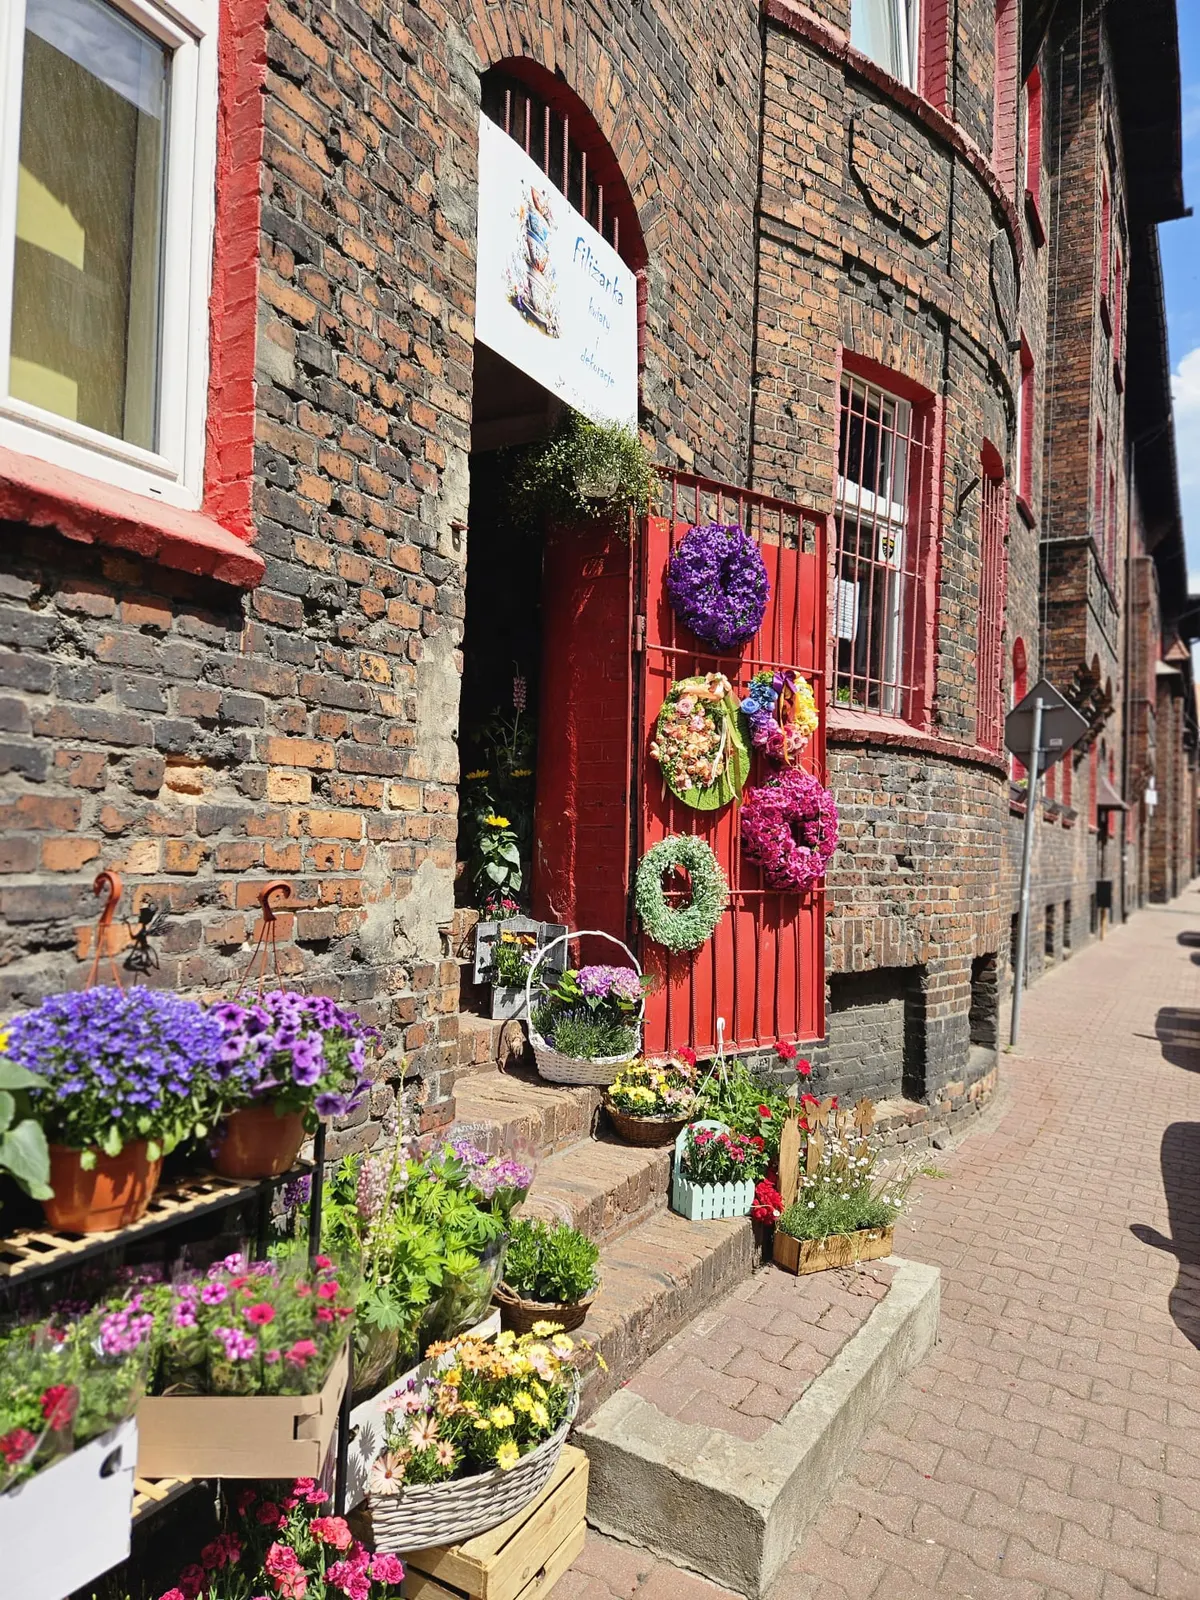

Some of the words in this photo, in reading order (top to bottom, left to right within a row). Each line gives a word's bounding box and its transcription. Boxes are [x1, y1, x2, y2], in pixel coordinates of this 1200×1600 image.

[573, 237, 624, 305] Filiżanka
[588, 297, 611, 335] kwiaty
[580, 348, 615, 389] dekoracje
